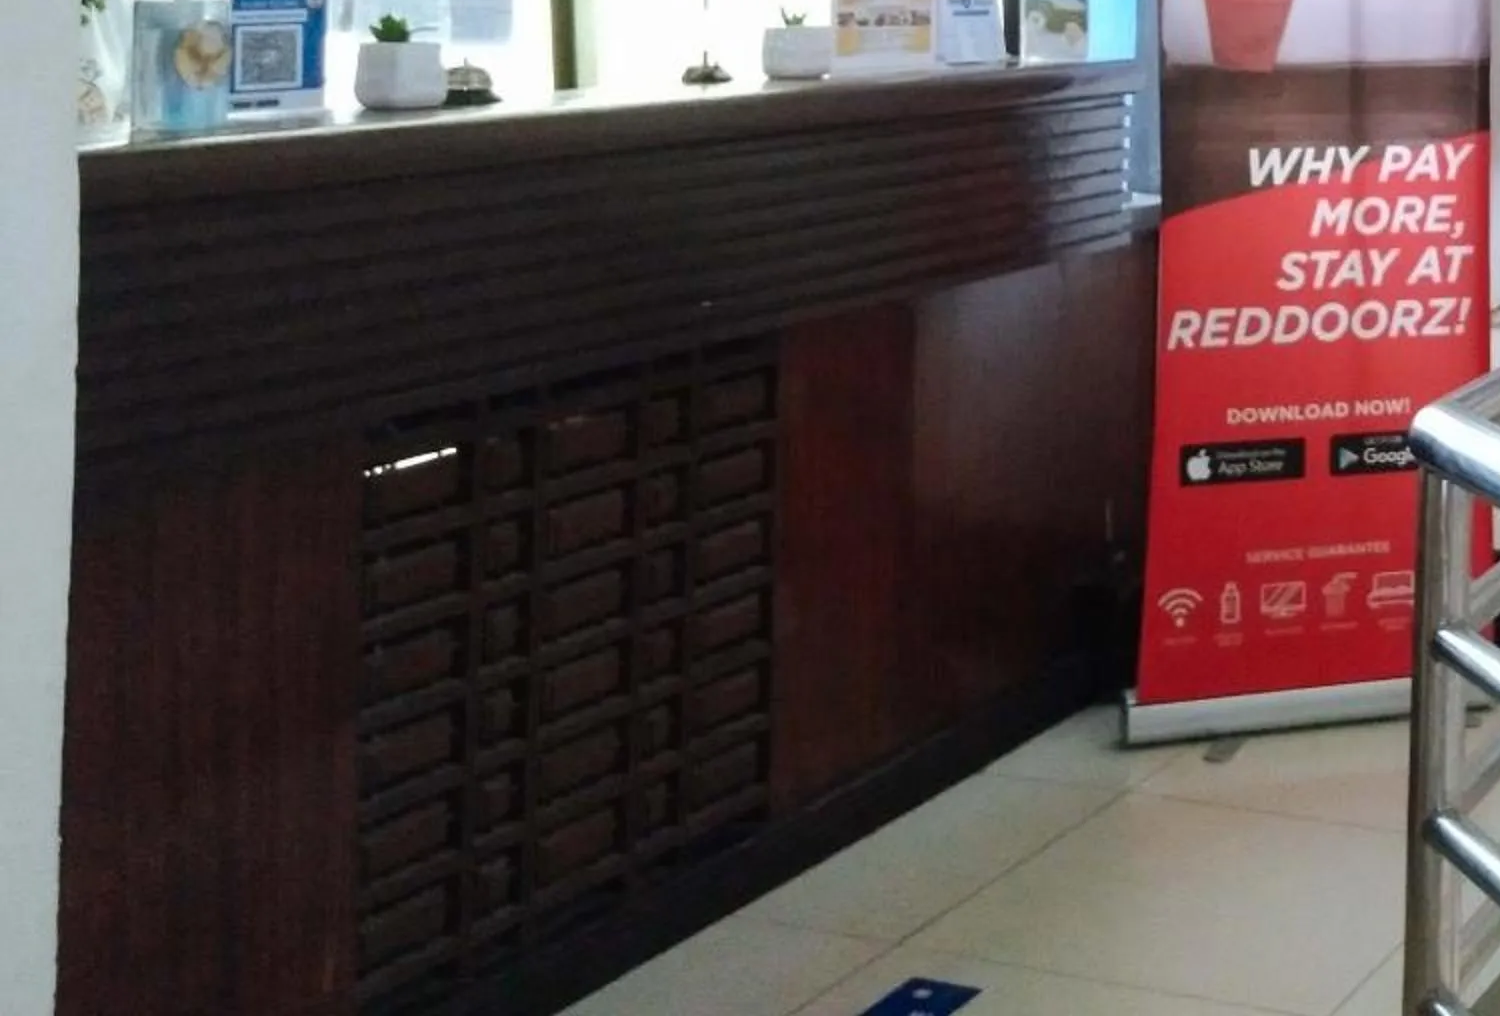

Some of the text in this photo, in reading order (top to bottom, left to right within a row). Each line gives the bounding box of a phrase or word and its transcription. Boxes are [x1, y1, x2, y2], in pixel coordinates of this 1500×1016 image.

[1249, 142, 1477, 188] WHY PAY
[1309, 194, 1465, 239] MORE,
[1275, 244, 1475, 292] STAY AT
[1167, 296, 1473, 351] REDDOORZ!
[1226, 396, 1412, 425] DOWNLOAD NOW!
[1217, 457, 1284, 476] App Store
